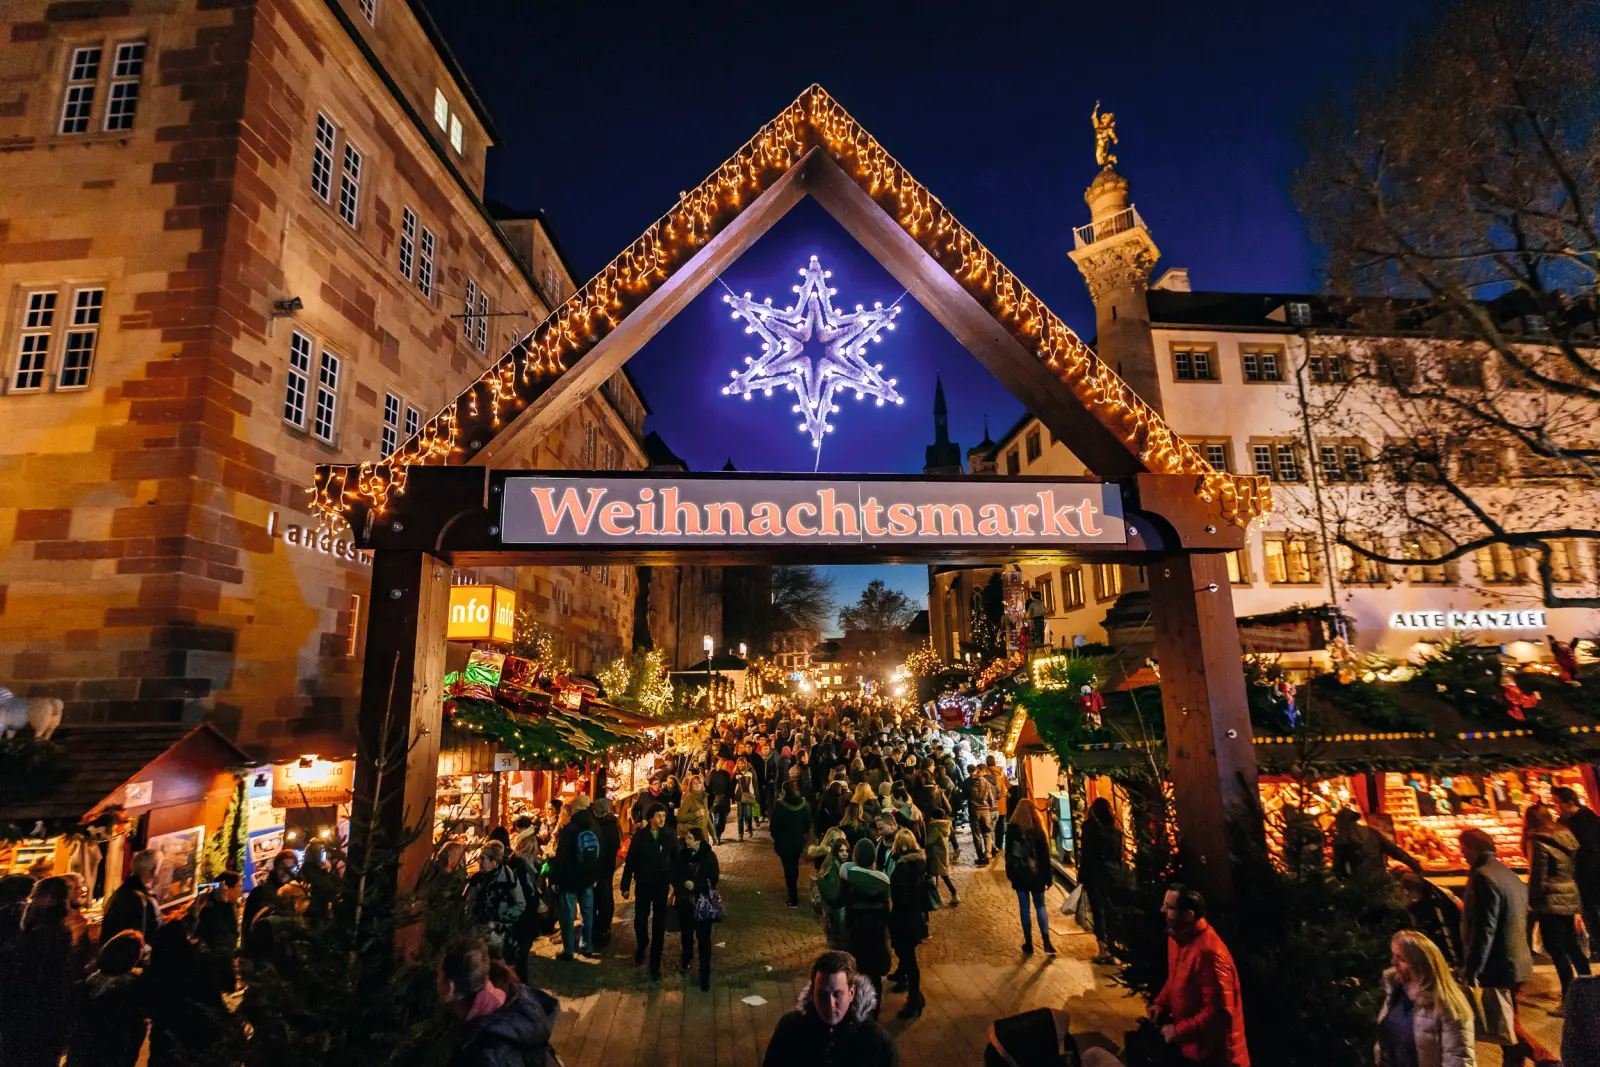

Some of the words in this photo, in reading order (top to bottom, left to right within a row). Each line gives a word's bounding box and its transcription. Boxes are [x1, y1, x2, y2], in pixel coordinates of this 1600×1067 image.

[530, 486, 1103, 538] Weihnachtsmarkt
[268, 511, 374, 566] Landesm
[452, 597, 490, 623] nfo
[496, 601, 514, 627] Info
[1392, 612, 1446, 628] ALTE
[1452, 611, 1548, 628] KANZLEI
[501, 758, 512, 767] S1
